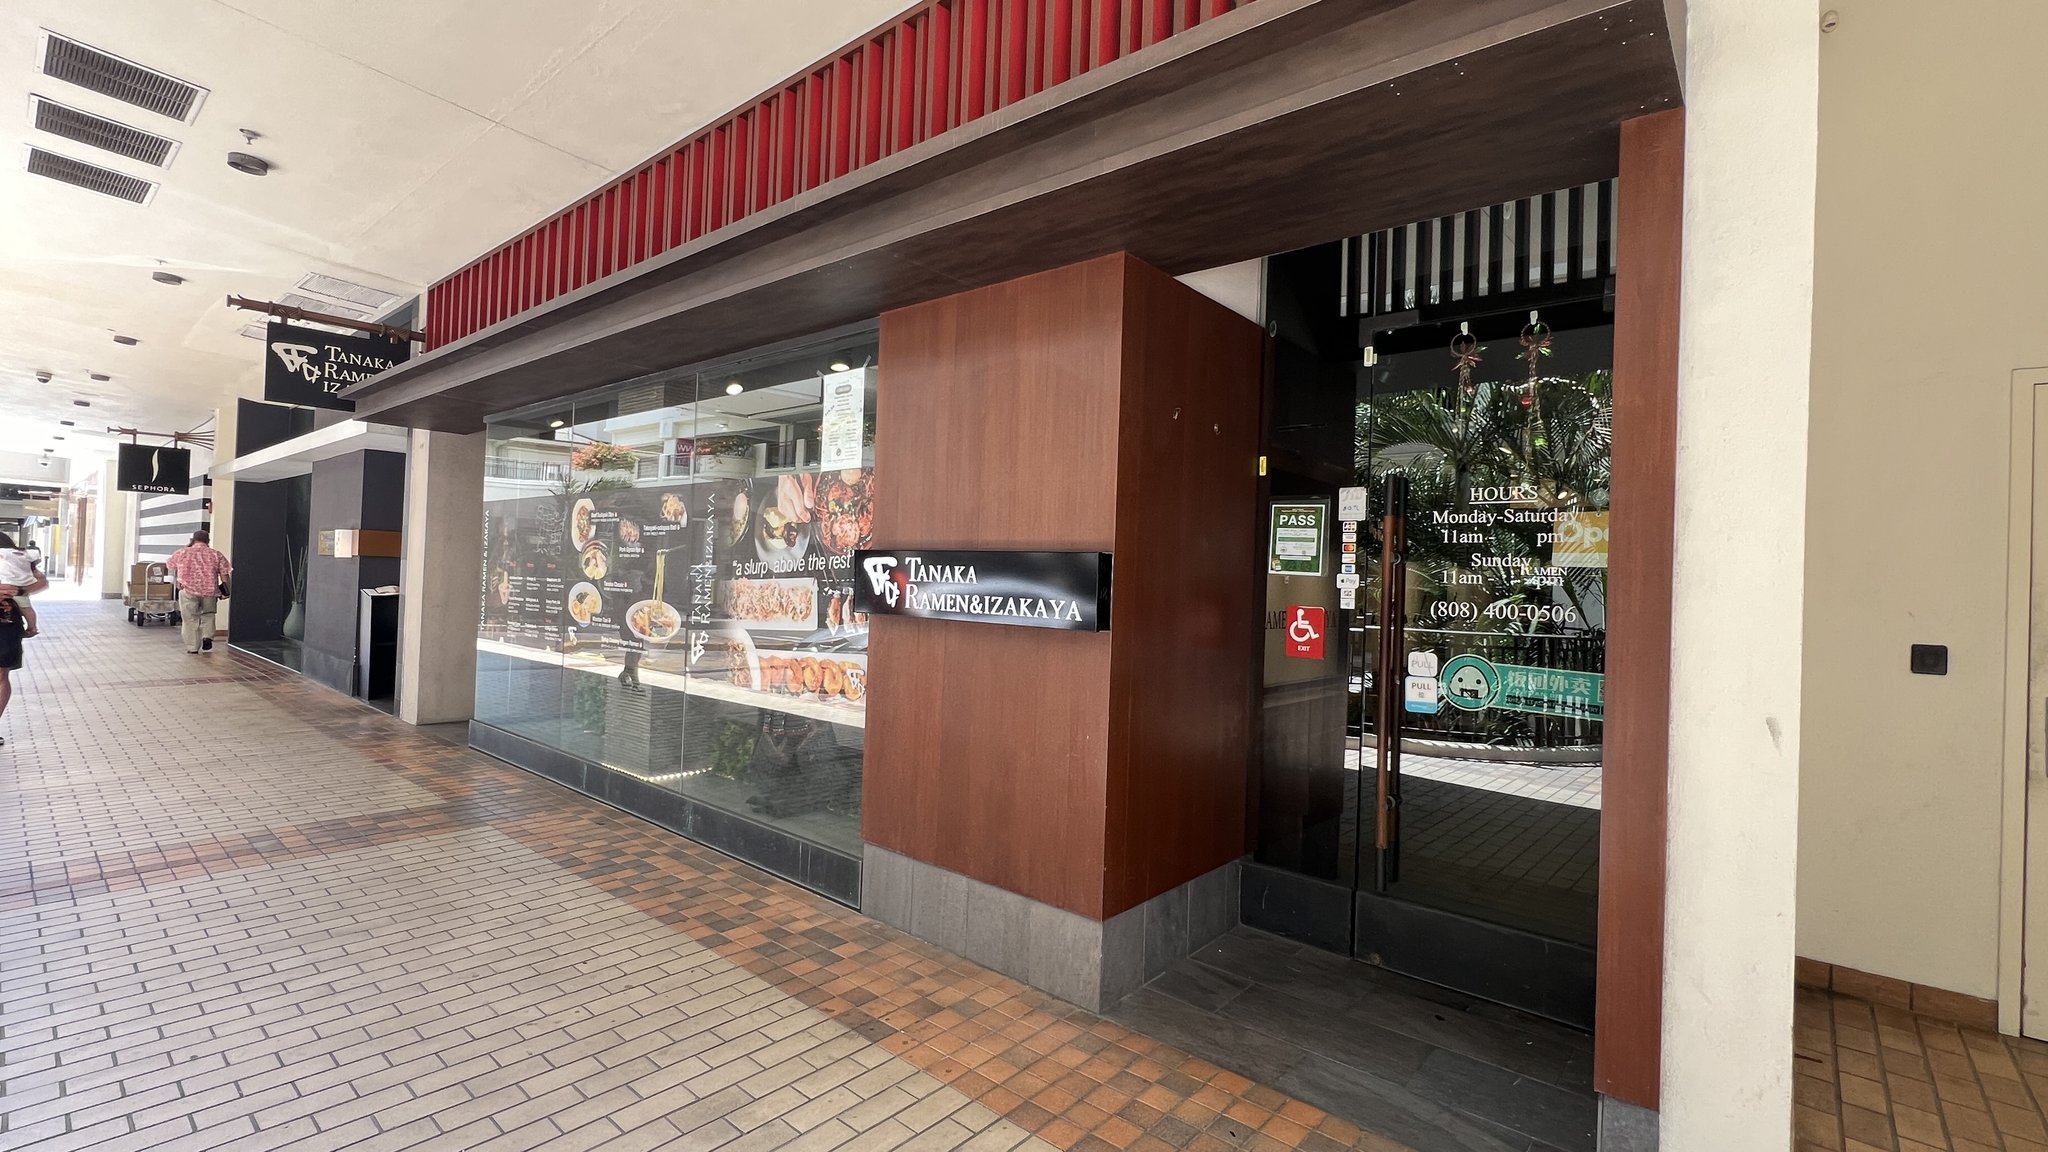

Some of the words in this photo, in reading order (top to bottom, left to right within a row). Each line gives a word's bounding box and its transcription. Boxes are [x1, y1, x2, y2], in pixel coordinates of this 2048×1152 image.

[324, 345, 394, 370] TANAKA
[132, 484, 175, 492] SEPHORA
[1470, 485, 1538, 502] HOURS
[1279, 514, 1316, 526] PASS
[1432, 507, 1579, 527] Monday-Saturday
[1441, 529, 1484, 544] 11am
[744, 558, 769, 577] slurp
[773, 555, 804, 573] above
[807, 552, 826, 571] the
[1471, 552, 1533, 571] Sunday
[1520, 562, 1568, 577] RAMEN
[904, 557, 978, 584] TANAKA
[1441, 570, 1483, 585] 11am
[1429, 600, 1478, 621] (808)
[1483, 602, 1577, 623] 400-0506
[1411, 660, 1434, 669] PULL
[1411, 682, 1432, 690] PULL
